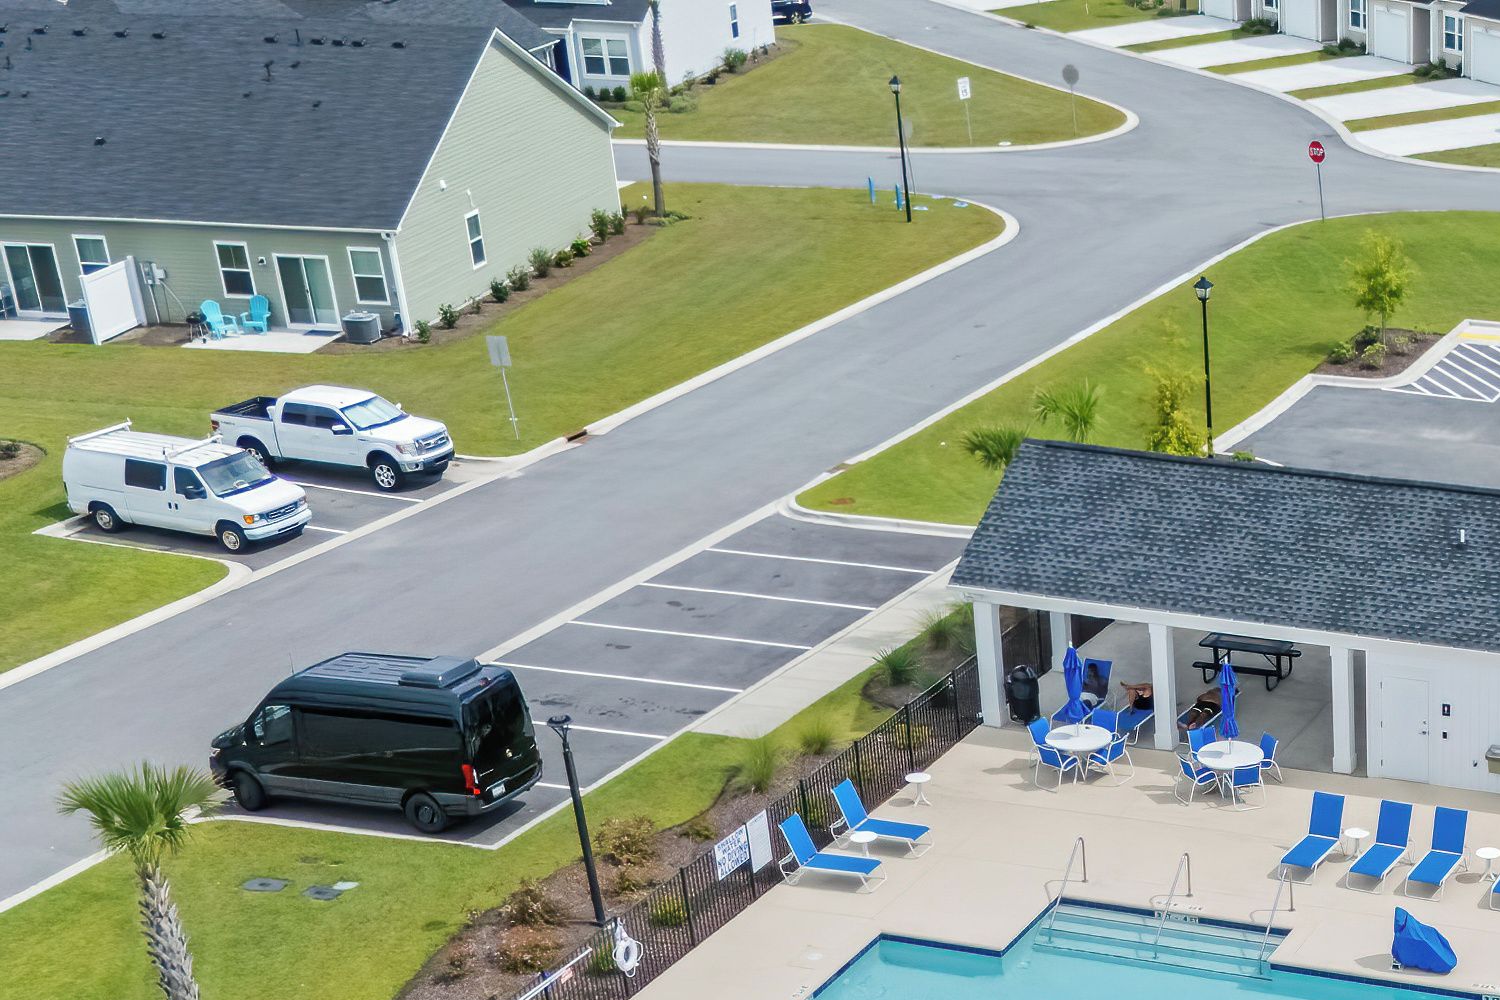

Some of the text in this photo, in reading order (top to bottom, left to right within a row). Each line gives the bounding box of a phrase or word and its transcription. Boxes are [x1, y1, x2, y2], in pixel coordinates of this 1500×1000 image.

[1309, 147, 1324, 156] STOP
[717, 828, 744, 850] SHALLOW
[722, 838, 741, 854] WATER
[718, 841, 748, 867] NO DIVING
[720, 851, 748, 878] ALLOWED
